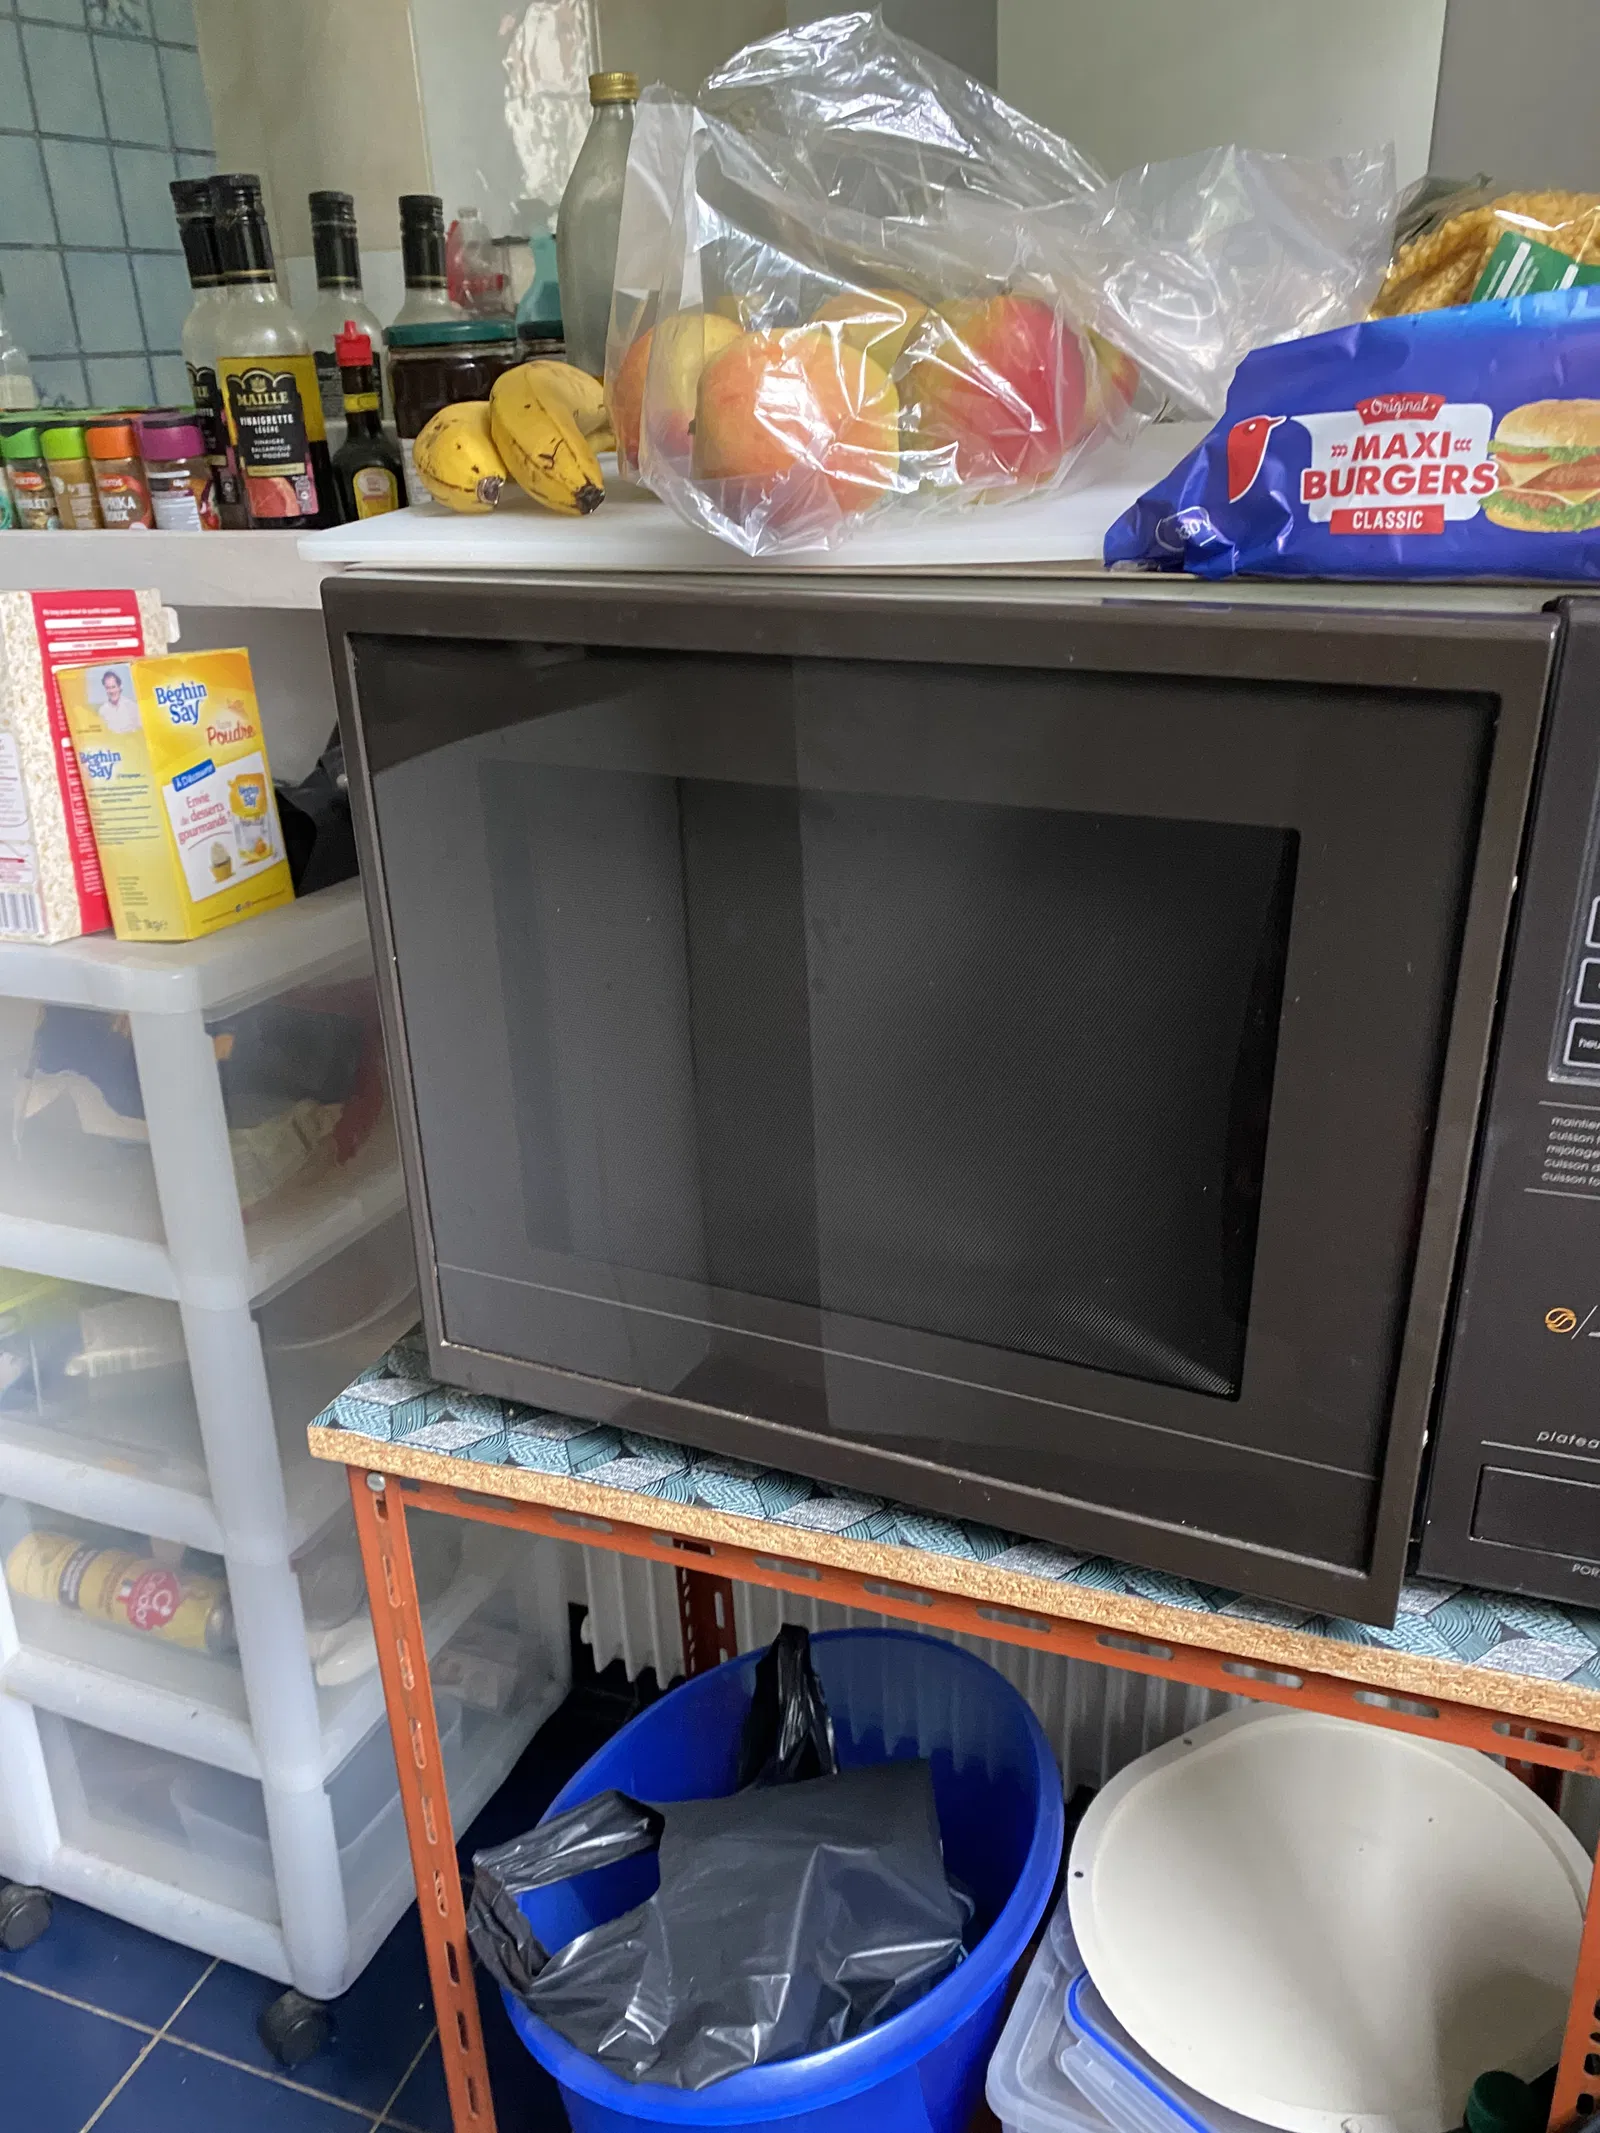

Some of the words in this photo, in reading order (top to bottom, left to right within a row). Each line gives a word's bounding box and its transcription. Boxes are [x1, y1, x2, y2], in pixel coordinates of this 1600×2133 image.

[236, 391, 290, 407] MAILLE
[1370, 395, 1429, 420] Original
[239, 413, 294, 427] VINAIGRETTE
[1351, 431, 1452, 462] MAXI
[1302, 463, 1498, 502] BURGERS
[1352, 509, 1424, 530] CLASSIC
[155, 681, 208, 706] Béghin
[169, 699, 200, 726] Say
[206, 720, 257, 747] Poudre
[88, 762, 114, 780] Say
[190, 802, 225, 822] desserts
[1548, 1131, 1595, 1144] cuisson
[1543, 1159, 1590, 1171] cuisson
[1541, 1172, 1587, 1184] cuisson
